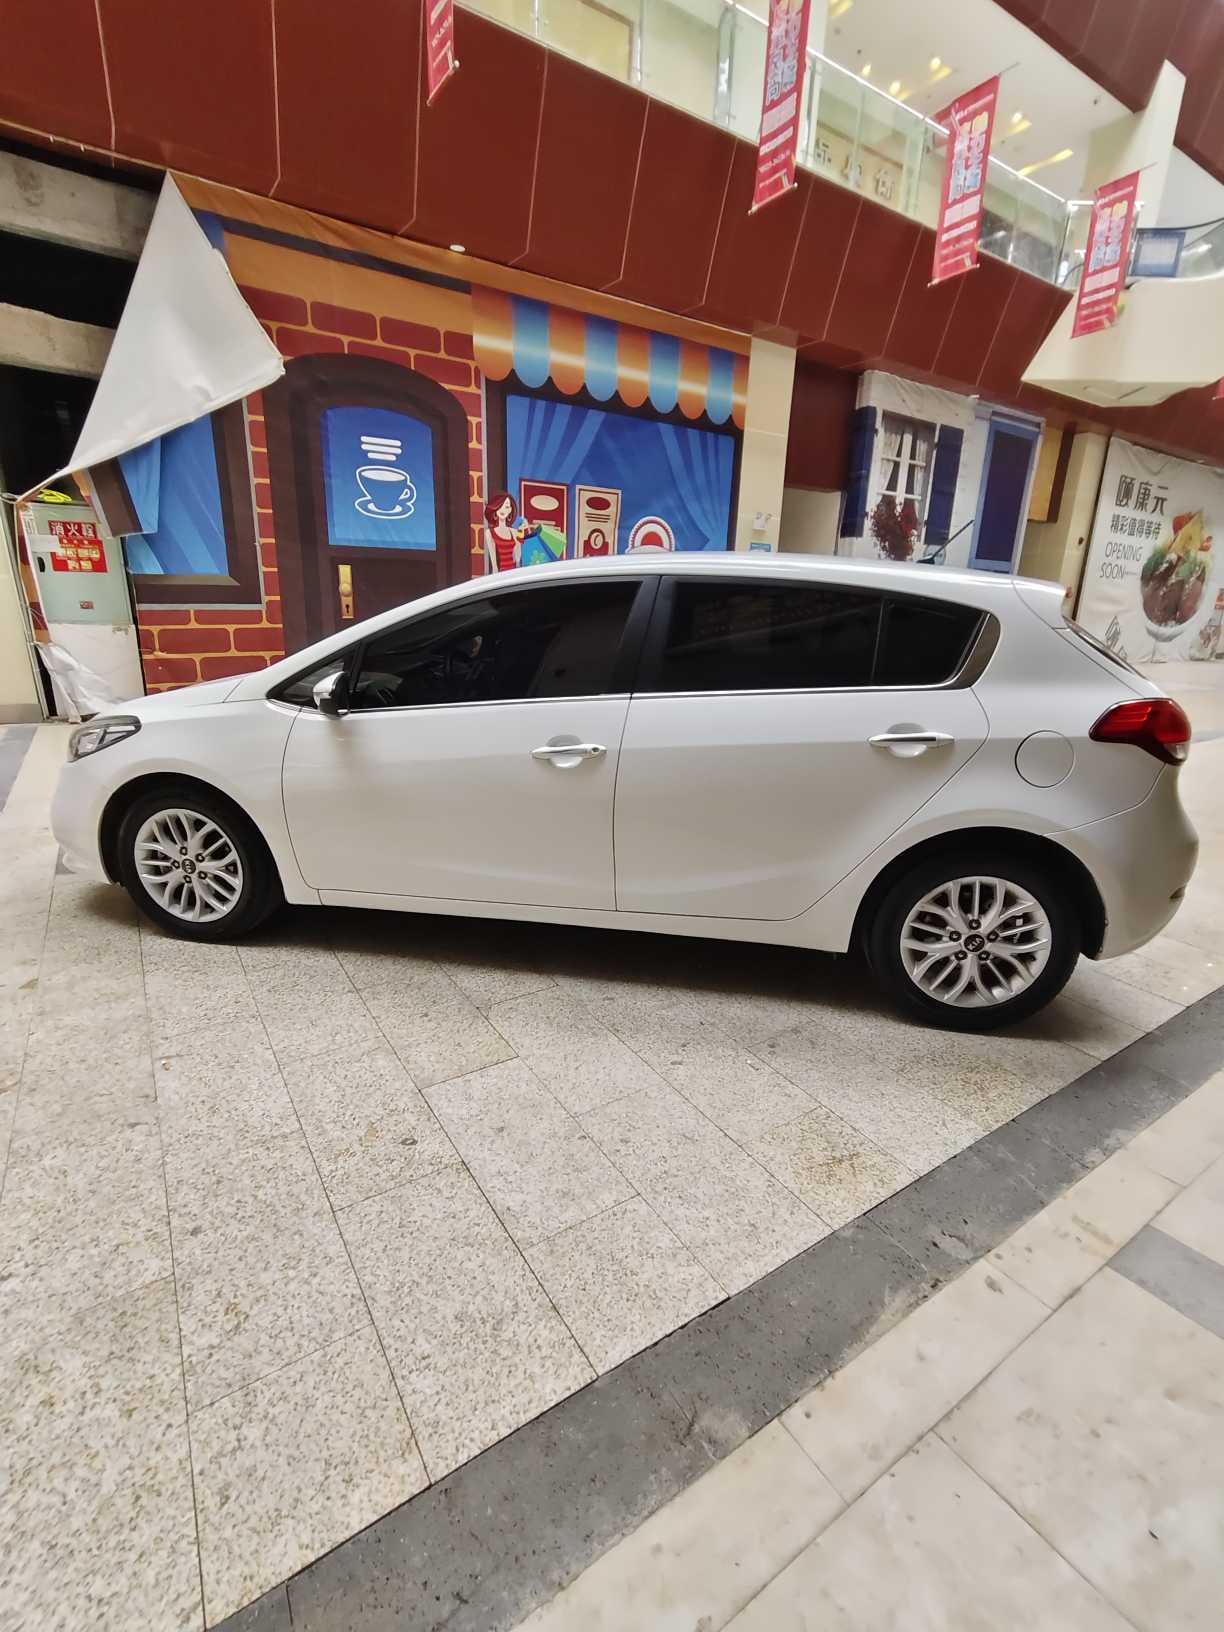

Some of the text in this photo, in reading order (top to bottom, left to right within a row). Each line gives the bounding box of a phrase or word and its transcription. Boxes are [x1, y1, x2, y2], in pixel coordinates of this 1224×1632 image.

[1115, 475, 1169, 516] 颐康元
[1110, 513, 1163, 540] 精彩值得等待
[1105, 542, 1143, 562] OPENING
